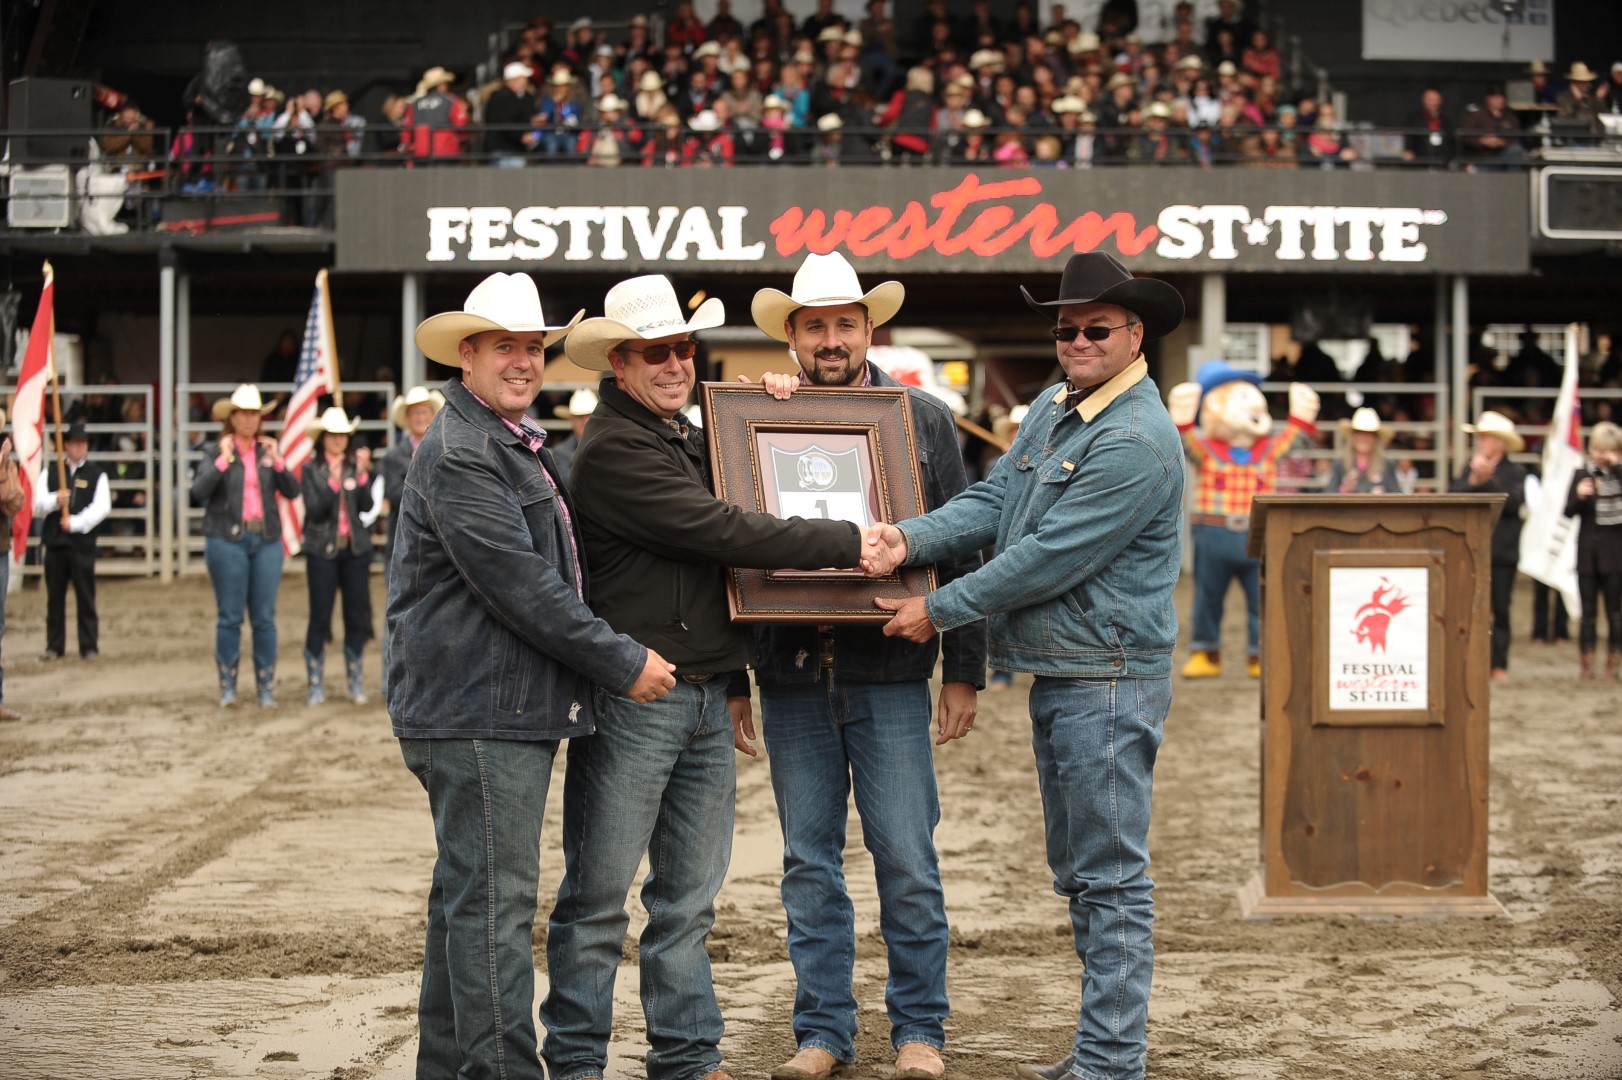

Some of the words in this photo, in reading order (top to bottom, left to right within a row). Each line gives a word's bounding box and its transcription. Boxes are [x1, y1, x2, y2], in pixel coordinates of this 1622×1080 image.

[426, 205, 766, 261] FESTIVAL
[769, 173, 1159, 259] western
[1342, 663, 1417, 675] FESTIVAL
[1336, 673, 1419, 689] western
